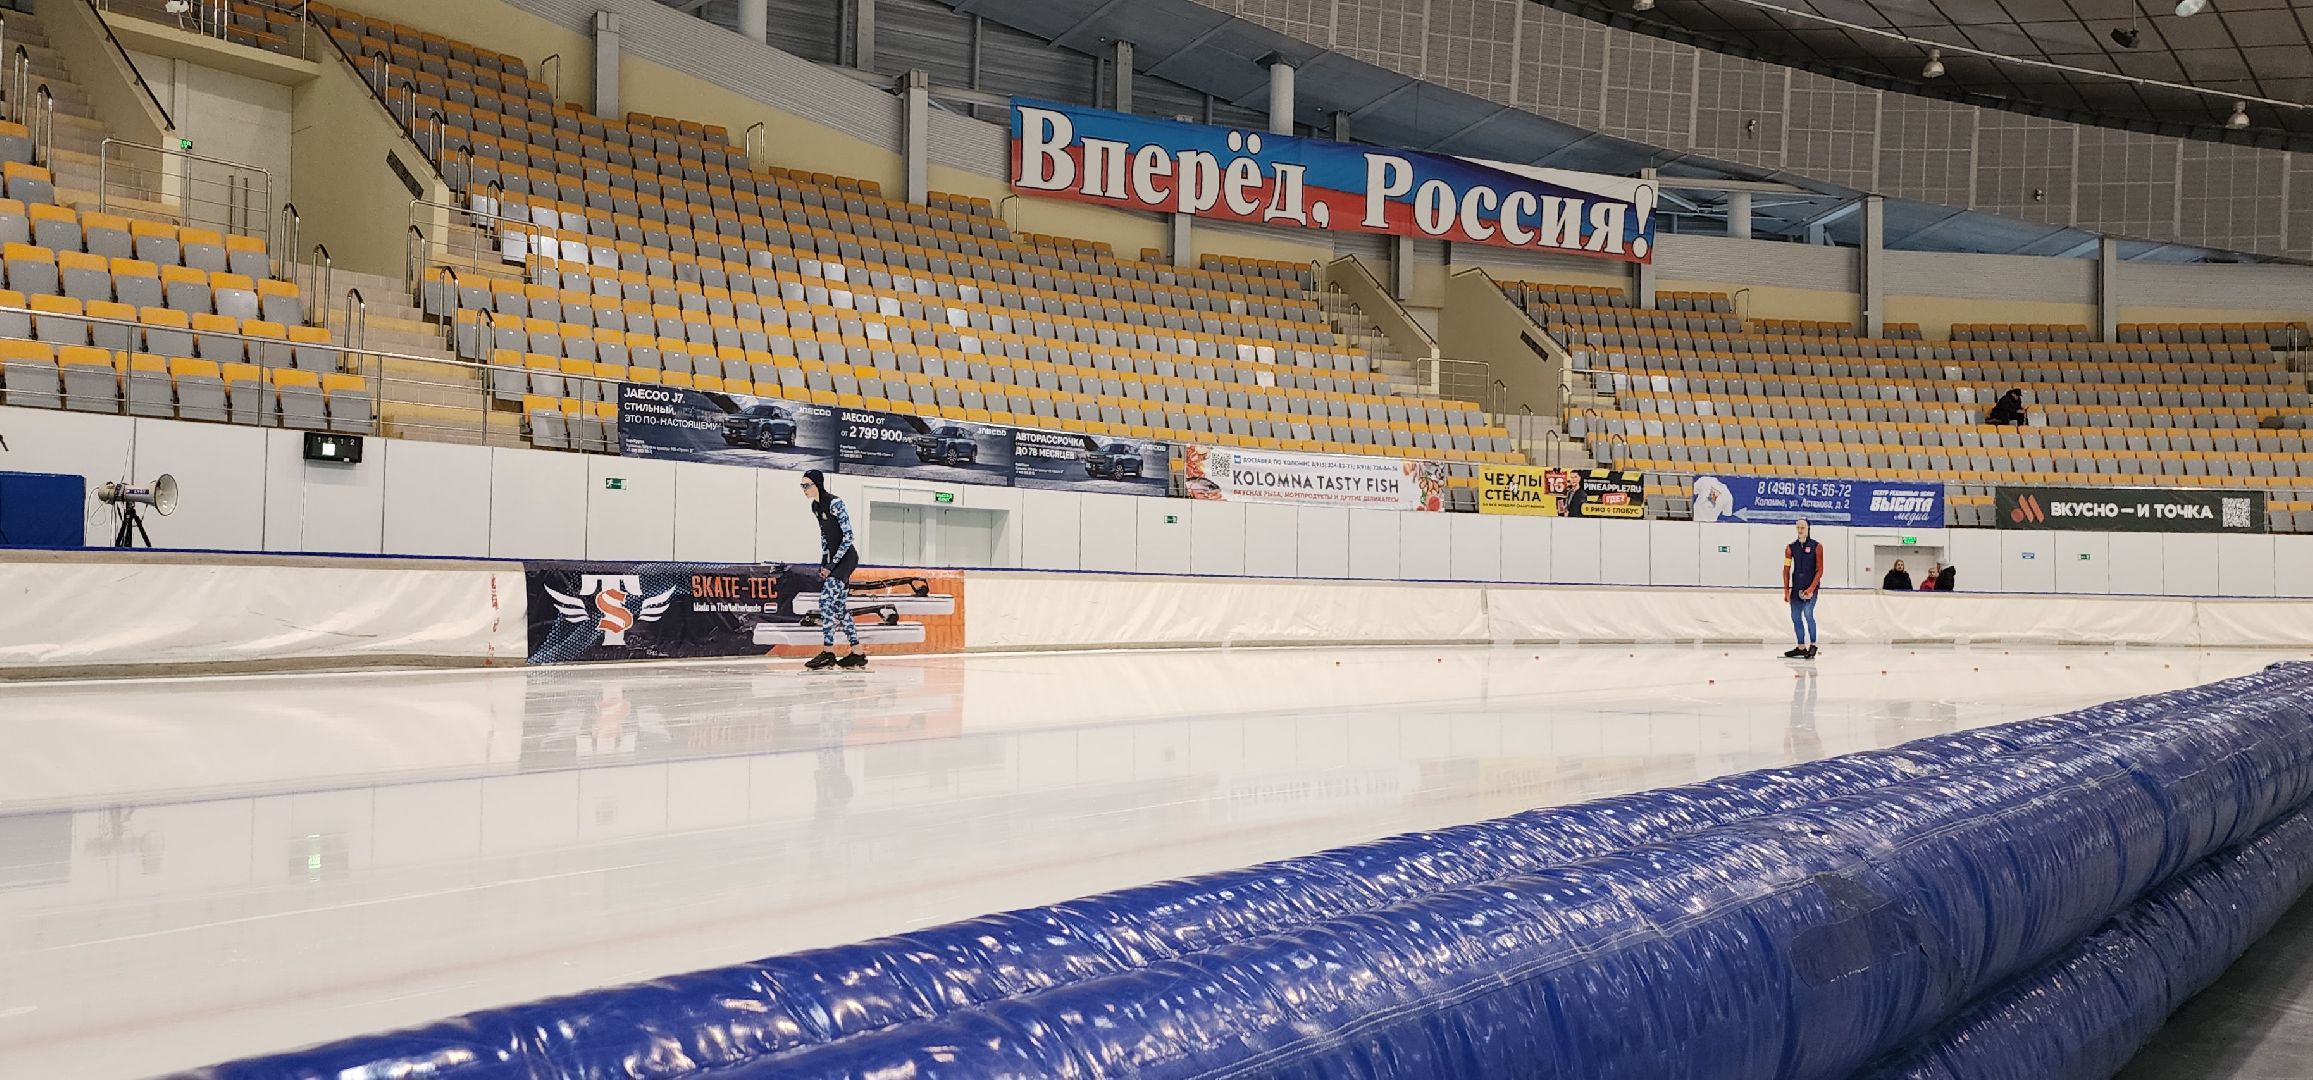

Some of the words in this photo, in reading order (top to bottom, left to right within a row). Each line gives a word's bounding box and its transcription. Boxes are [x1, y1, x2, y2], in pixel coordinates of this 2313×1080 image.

[1015, 105, 1330, 229] Вперёд,
[1361, 152, 1654, 258] Россия!
[624, 387, 669, 401] JAECOO
[624, 414, 642, 423] ЭТО
[841, 411, 875, 424] JAECOO
[849, 425, 857, 438] 2
[858, 426, 879, 440] 799
[880, 430, 903, 443] 900
[1015, 431, 1085, 447] АВТОРАССРОЧКА
[1015, 446, 1028, 457] ДО
[1039, 448, 1075, 460] МЕСЯЦЕВ
[1233, 470, 1314, 489] KOLOMNA
[1317, 475, 1361, 491] TASTY
[1366, 477, 1399, 493] FISH
[1484, 473, 1542, 487] ЧЕХЛЫ
[1485, 487, 1541, 501] СТЁКЛА
[1757, 481, 1766, 495] 8
[1768, 482, 1795, 495] (496)
[1798, 482, 1852, 497] 615-56-72
[1844, 499, 1850, 509] 2
[1869, 496, 1935, 512] ВЫСОТА
[2050, 501, 2119, 517] ВКУСНО
[2137, 503, 2150, 517] И
[2153, 503, 2214, 519] ТОЧКА
[1893, 512, 1930, 526] медиа
[691, 574, 779, 599] SKATE-TEC
[693, 602, 709, 612] Made
